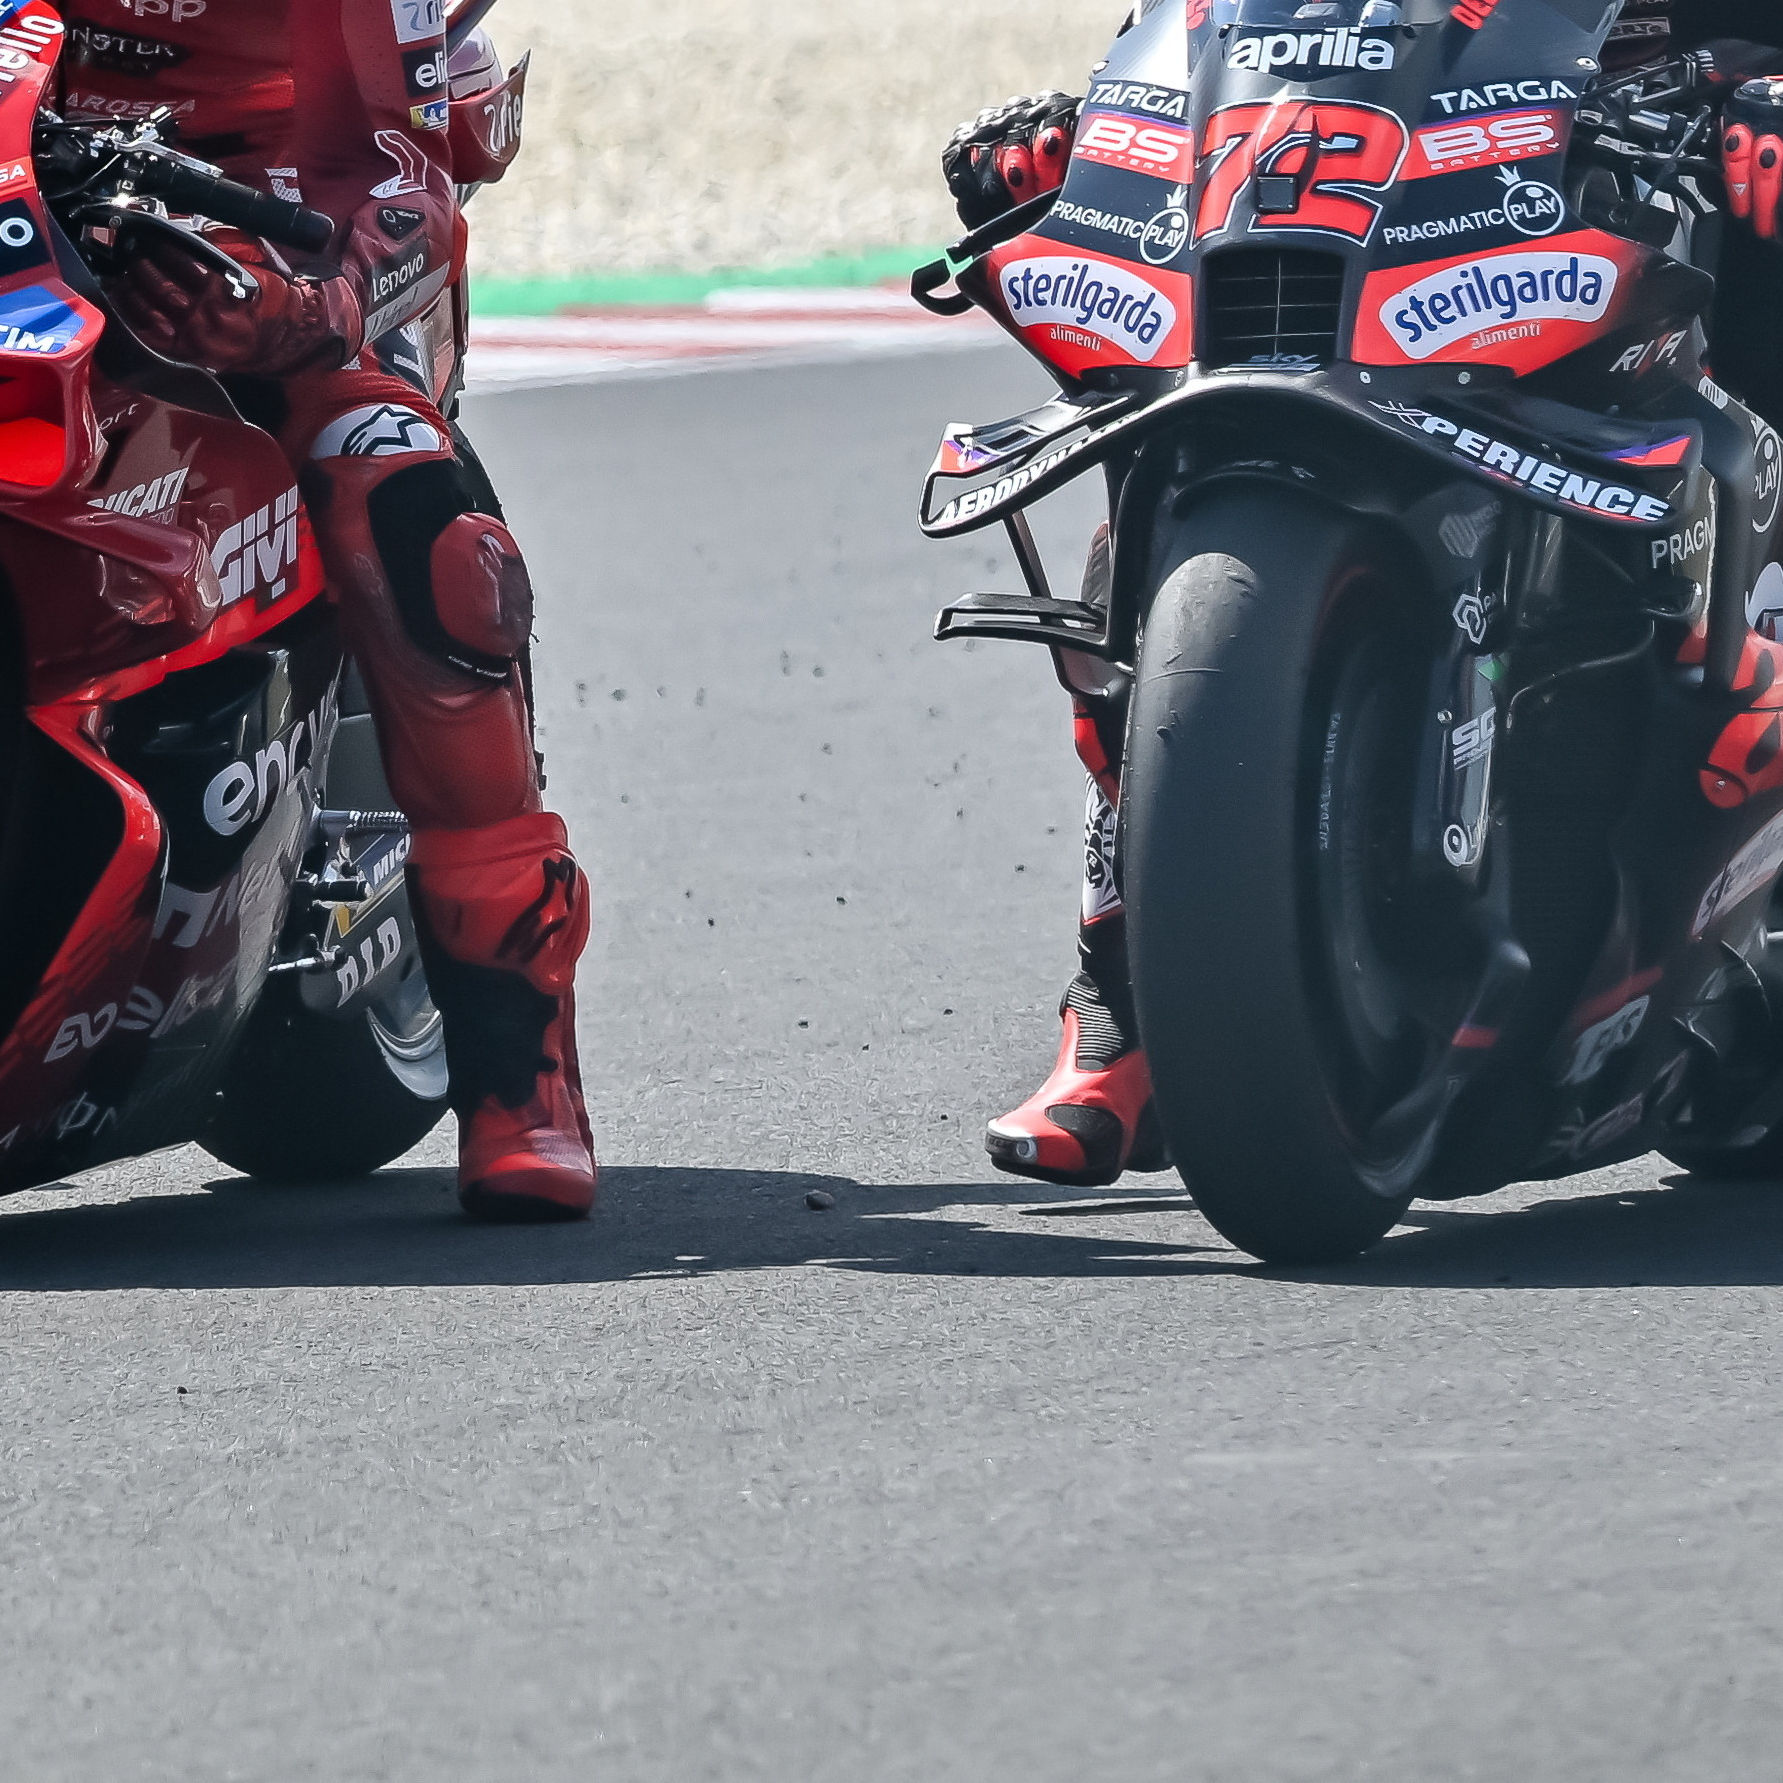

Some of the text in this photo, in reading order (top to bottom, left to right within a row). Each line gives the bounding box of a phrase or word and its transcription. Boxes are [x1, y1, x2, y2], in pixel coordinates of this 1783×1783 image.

[1227, 27, 1395, 74] aprilia
[1089, 82, 1187, 118] TARGA
[1429, 79, 1578, 114] TARGA
[1074, 146, 1170, 174] BATTERY
[1078, 118, 1190, 164] BS
[1418, 113, 1555, 162] BS
[1430, 142, 1561, 171] BATTERY
[1189, 95, 1412, 252] 72
[1050, 200, 1184, 249] PRAGMATIC PLAY
[1382, 197, 1557, 245] PRAGMATIC PLAY
[372, 252, 424, 303] Lenovo
[1395, 256, 1603, 343] sterilgarda
[1007, 263, 1163, 345] sterilgarda
[1050, 325, 1103, 352] alimenti
[1470, 321, 1541, 350] alimenti
[209, 484, 299, 607] GIVI
